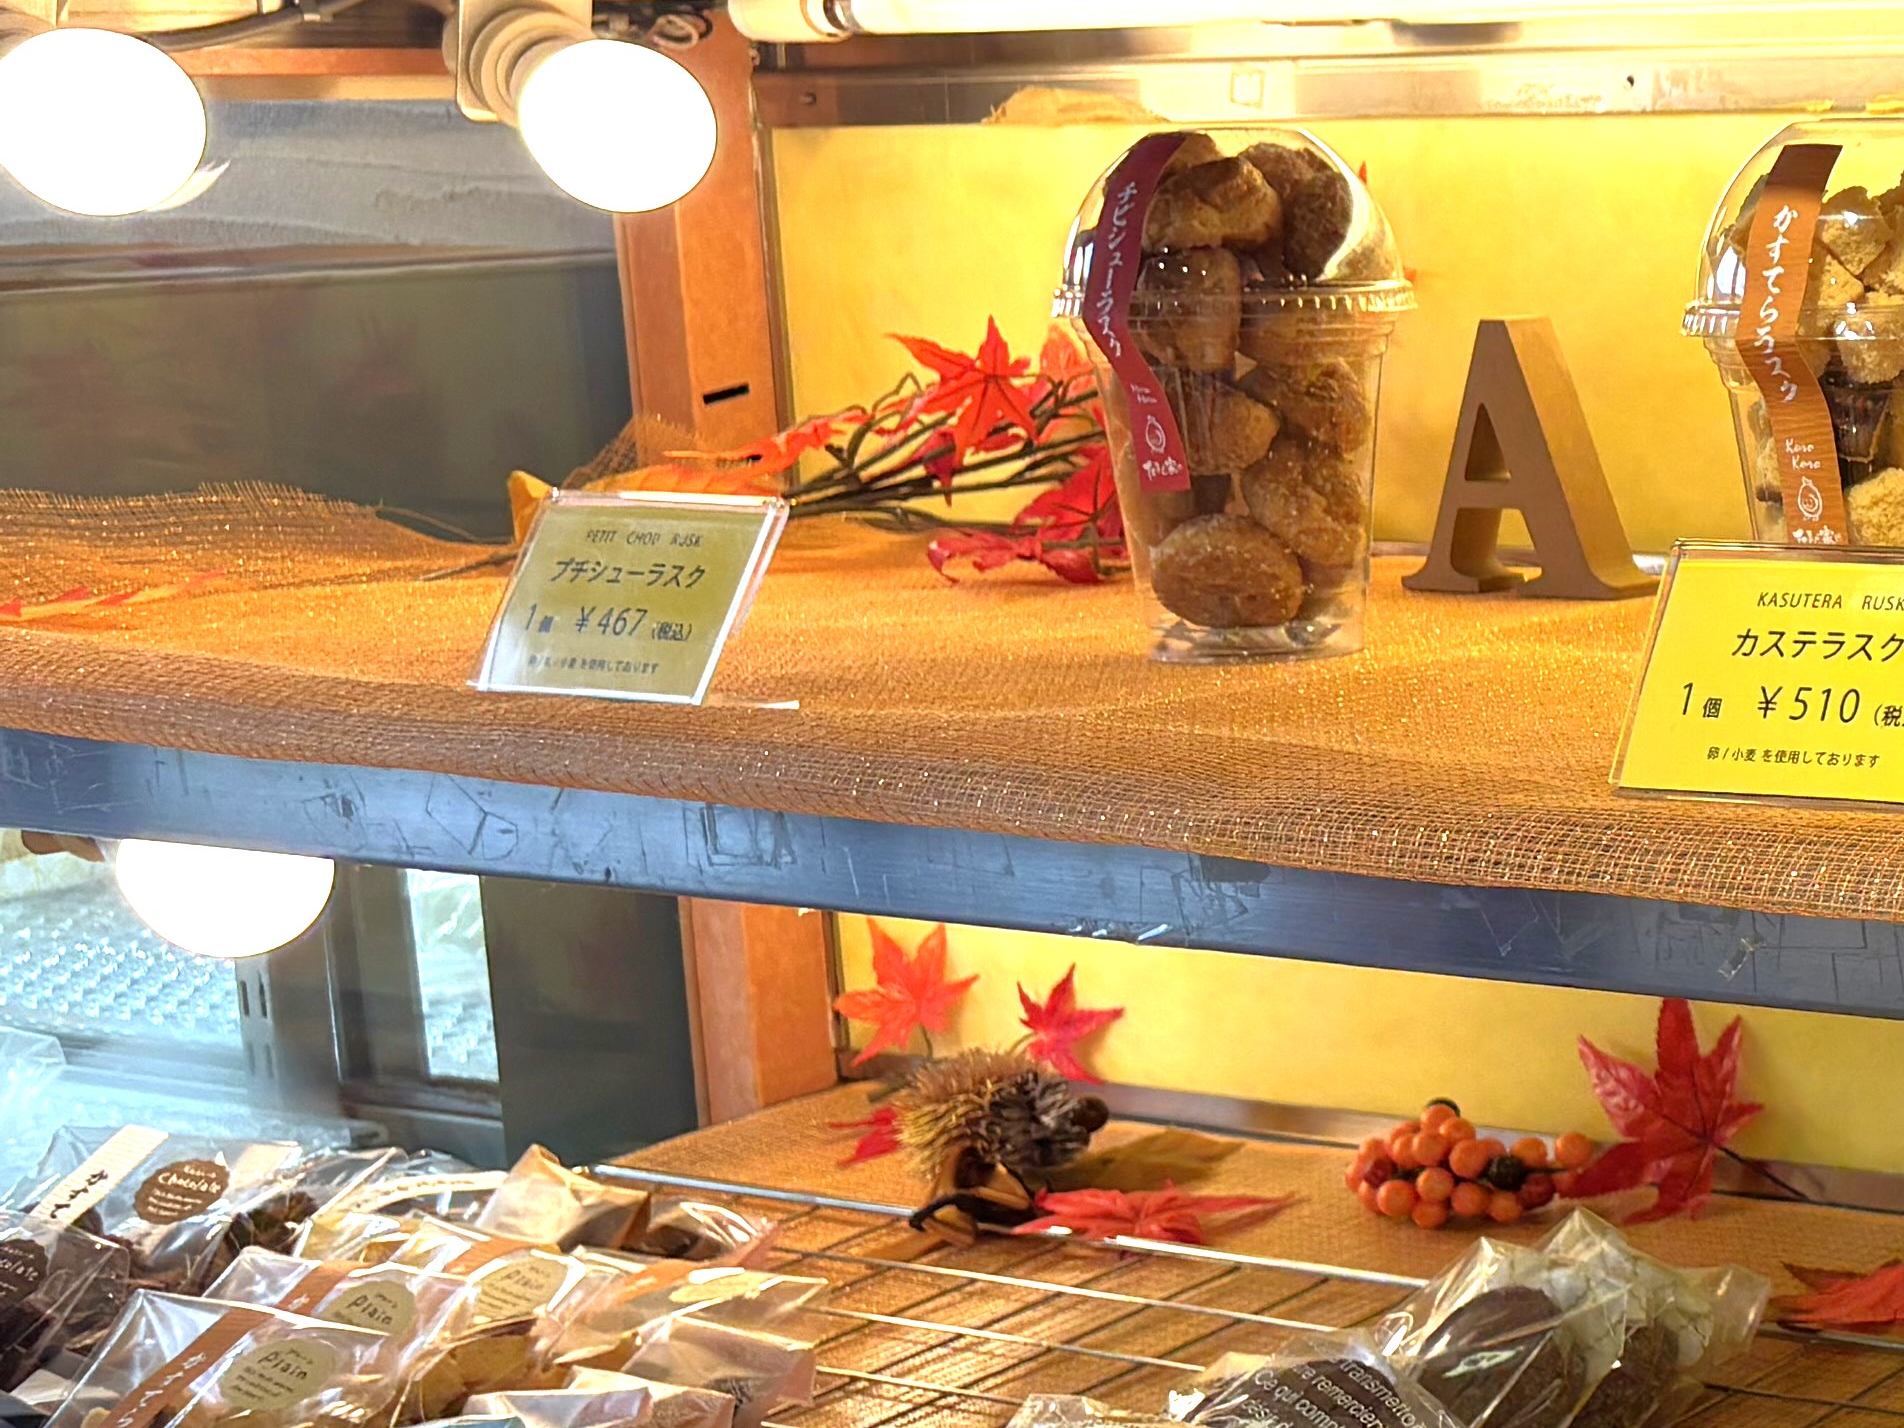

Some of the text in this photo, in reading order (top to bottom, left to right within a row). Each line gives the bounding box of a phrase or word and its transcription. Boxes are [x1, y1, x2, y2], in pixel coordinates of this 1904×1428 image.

[1754, 204, 1799, 403] かすてらラスク
[550, 557, 705, 589] プチシューラスク
[1757, 591, 1843, 609] KASUTERA
[1731, 628, 1904, 663] カステラスク
[257, 1350, 308, 1380] Plain
